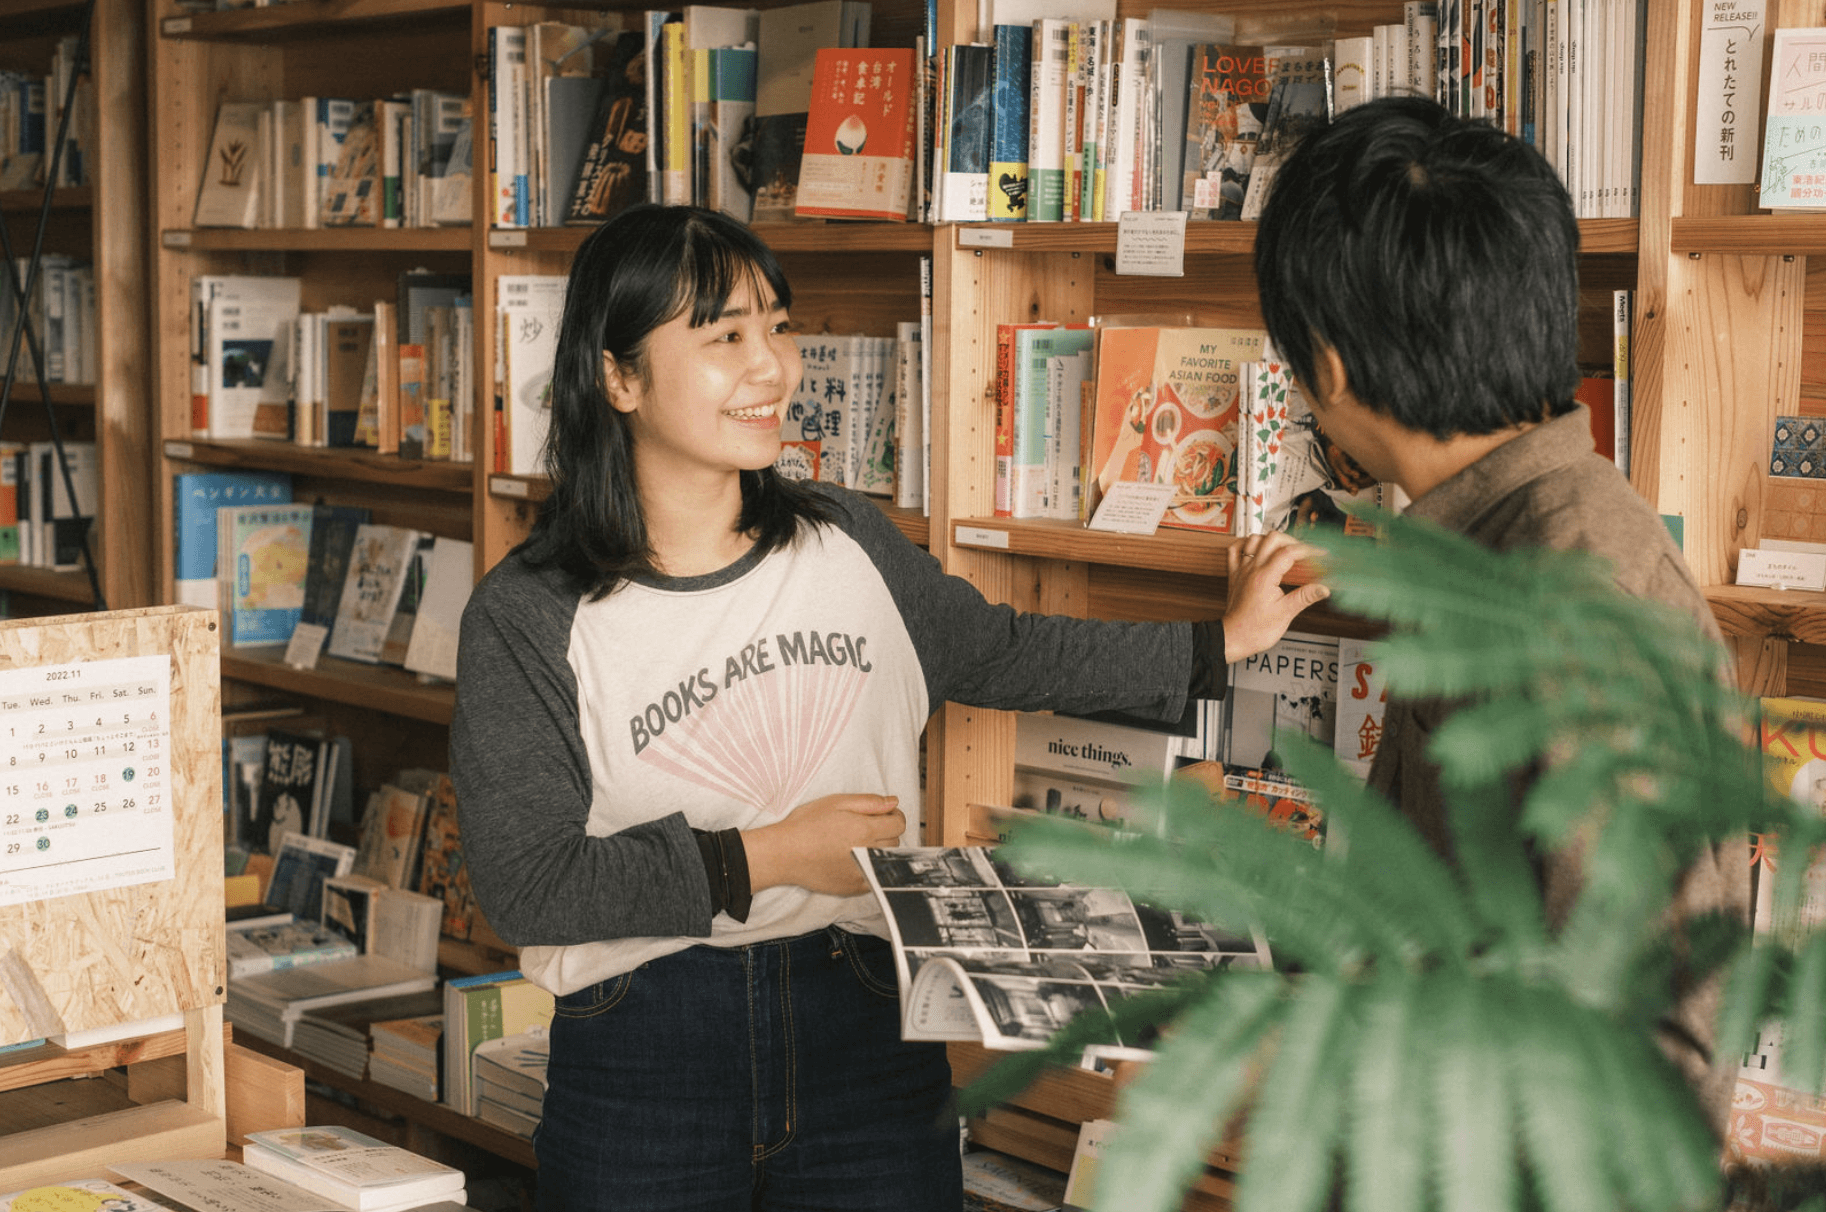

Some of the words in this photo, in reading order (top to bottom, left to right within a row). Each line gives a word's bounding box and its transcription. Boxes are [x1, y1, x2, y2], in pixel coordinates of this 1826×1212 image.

[1713, 2, 1737, 11] NEW
[1713, 11, 1758, 22] RELEASE!!
[1719, 38, 1737, 161] とれたての新刊
[1200, 344, 1217, 354] MY
[1180, 356, 1231, 370] FAVORITE
[1169, 370, 1202, 382] ASIAN
[1205, 372, 1238, 384] FOOD
[46, 669, 81, 681] 2022.11
[2, 701, 21, 710] Tue.
[30, 697, 53, 707] Wed.
[62, 695, 81, 703] Thu.
[90, 691, 104, 700] Fri.
[113, 689, 129, 698] Sat.
[138, 686, 156, 695] Sun.
[630, 667, 718, 756] BOOKS
[725, 638, 775, 689] ARE
[776, 630, 872, 673] MAGIC
[10, 728, 15, 737] 1
[38, 724, 45, 734] 2
[67, 720, 74, 731] 3
[95, 717, 102, 726] 4
[123, 714, 130, 724] 5
[150, 711, 157, 721] 6
[10, 756, 17, 766] 8
[39, 753, 46, 763] 9
[65, 749, 78, 759] 10
[94, 745, 105, 756] 11
[123, 742, 135, 752] 12
[148, 738, 160, 749] 13
[1048, 738, 1079, 758] nice
[1081, 743, 1132, 769] things.
[6, 785, 20, 796] 15
[36, 781, 49, 792] 16
[65, 778, 78, 788] 17
[94, 774, 107, 784] 18
[122, 769, 135, 781] 19
[147, 767, 161, 777] 20
[6, 814, 20, 825] 22
[36, 810, 50, 821] 23
[65, 805, 78, 817] 24
[94, 801, 107, 813] 25
[122, 798, 136, 809] 26
[148, 795, 161, 805] 27
[7, 843, 21, 854] 29
[36, 838, 51, 850] 30
